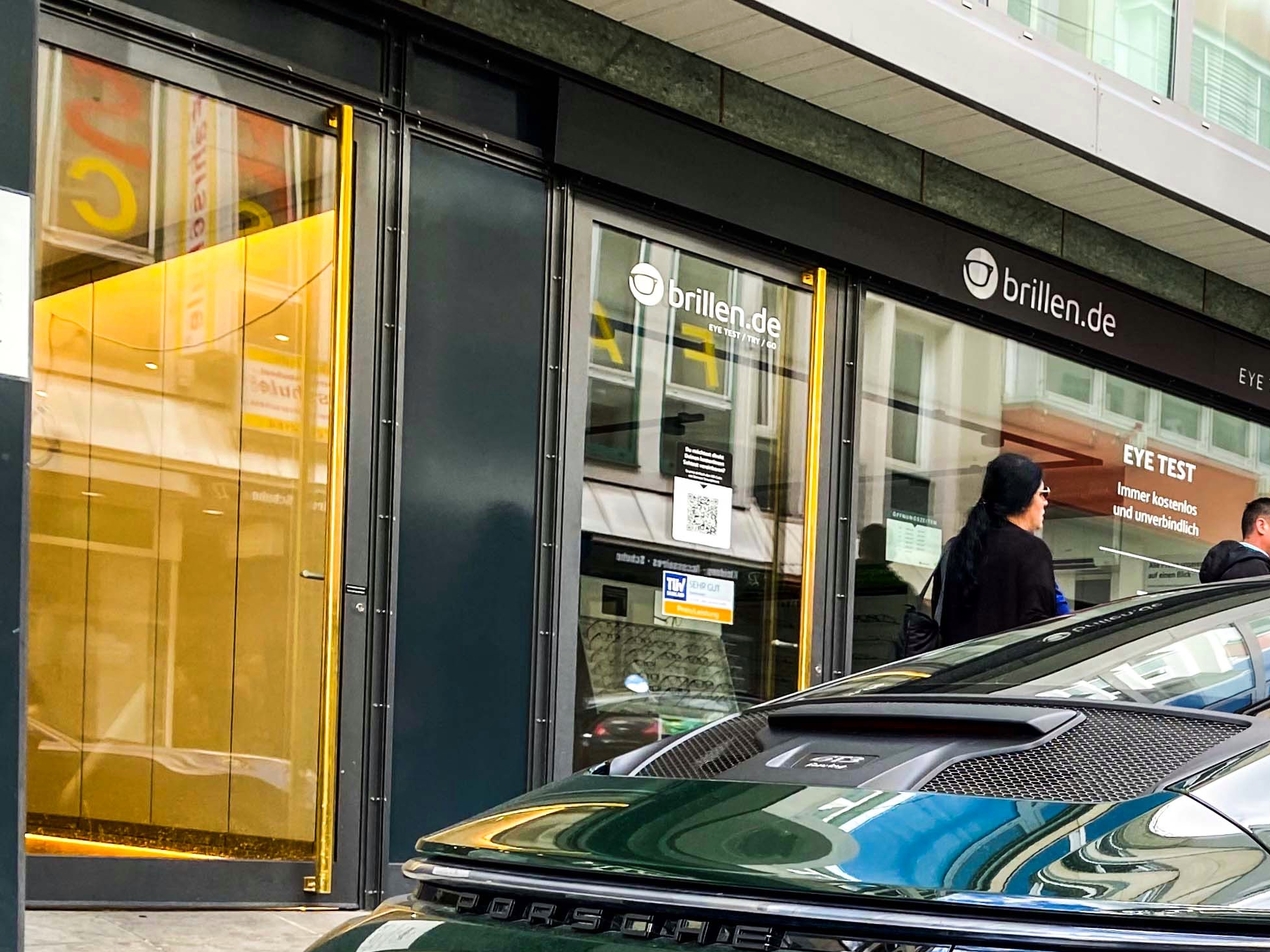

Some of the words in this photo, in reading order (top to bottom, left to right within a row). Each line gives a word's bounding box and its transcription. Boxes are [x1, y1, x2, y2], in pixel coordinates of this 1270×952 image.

[668, 278, 781, 338] brillen.de
[1003, 267, 1116, 337] brillen.de
[708, 323, 722, 334] EYE
[724, 327, 741, 339] TEST
[1239, 367, 1264, 391] EYE
[1123, 443, 1154, 472] EYE
[1157, 453, 1197, 483] TEST
[1117, 481, 1150, 503] Immer
[1152, 491, 1198, 516] kostenlos
[1113, 505, 1133, 520] und
[1135, 511, 1199, 537] unverbindlich
[455, 892, 774, 951] PORSCHE
